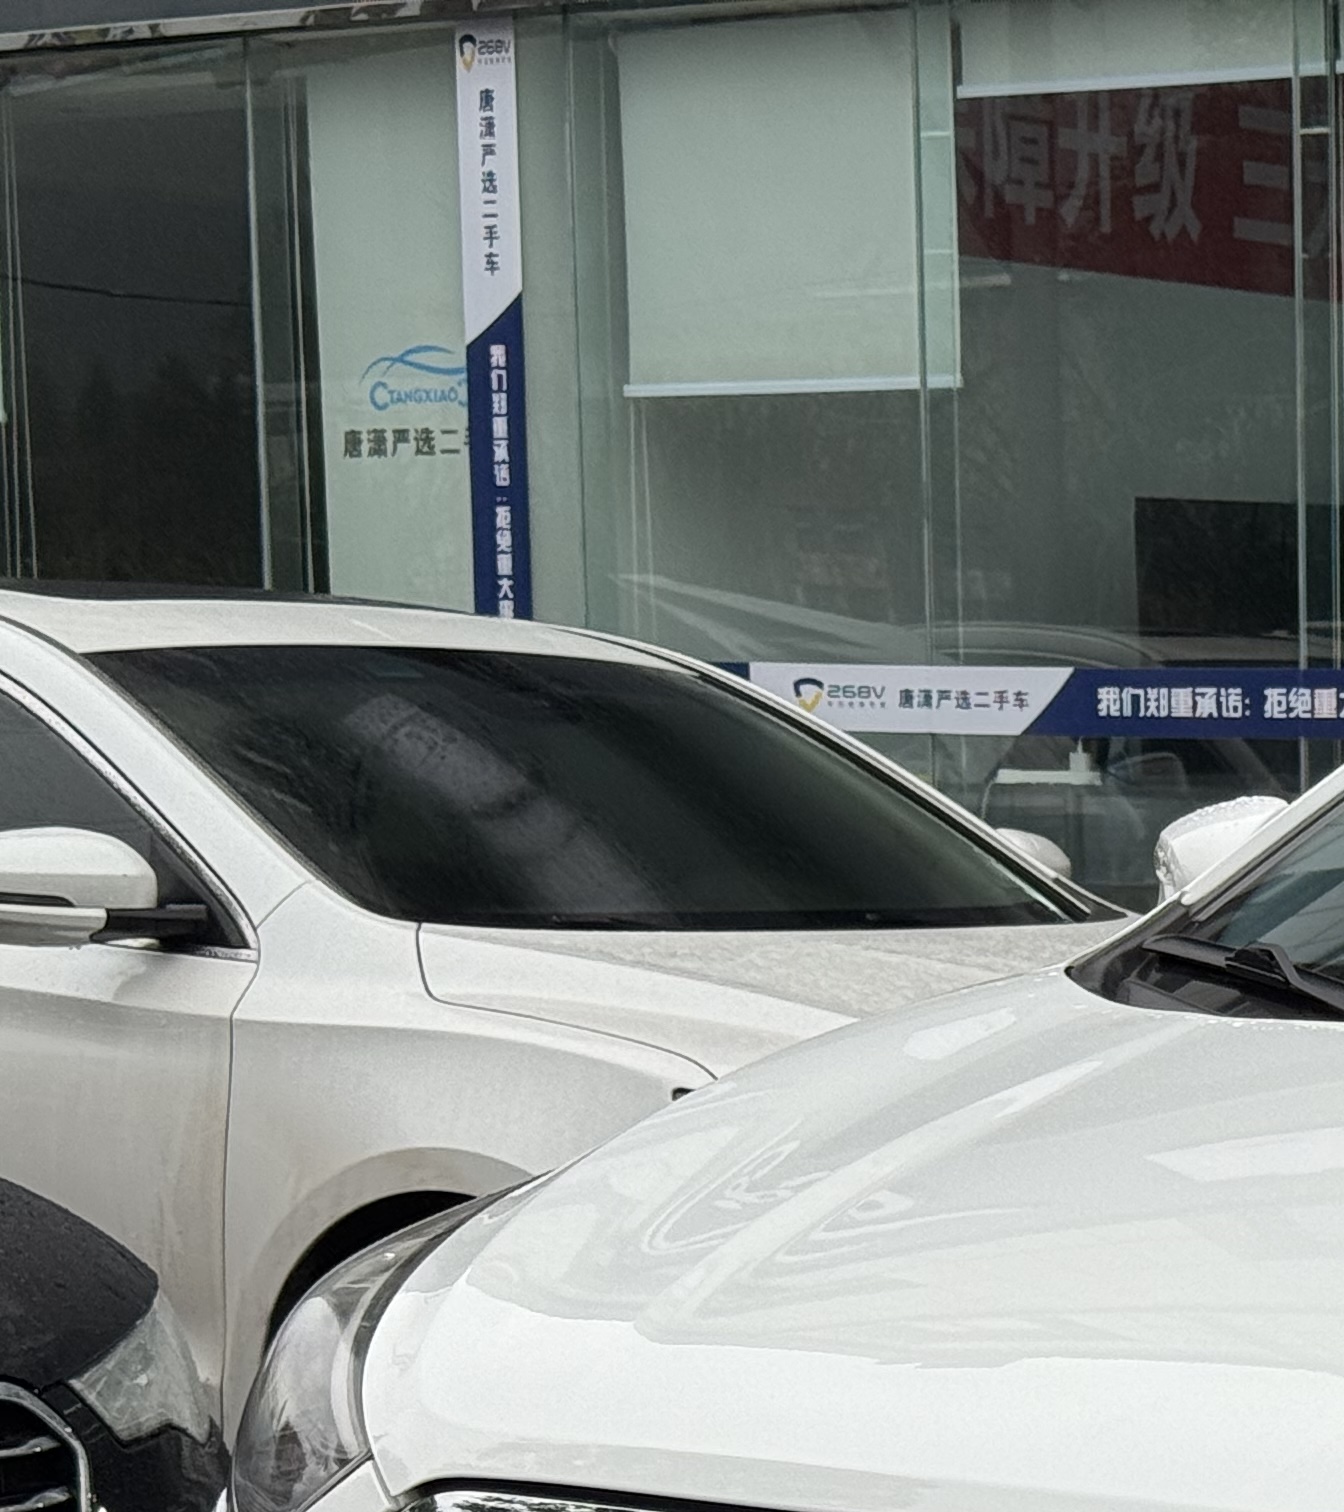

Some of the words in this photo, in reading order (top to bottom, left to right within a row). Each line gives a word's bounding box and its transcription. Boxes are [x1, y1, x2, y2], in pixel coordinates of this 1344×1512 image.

[478, 87, 502, 276] 唐潇严选二手车
[958, 91, 1202, 243] 障升级
[342, 427, 470, 460] 唐潇严选二
[827, 684, 886, 700] 268V
[898, 688, 1030, 711] 唐潇严选二手车
